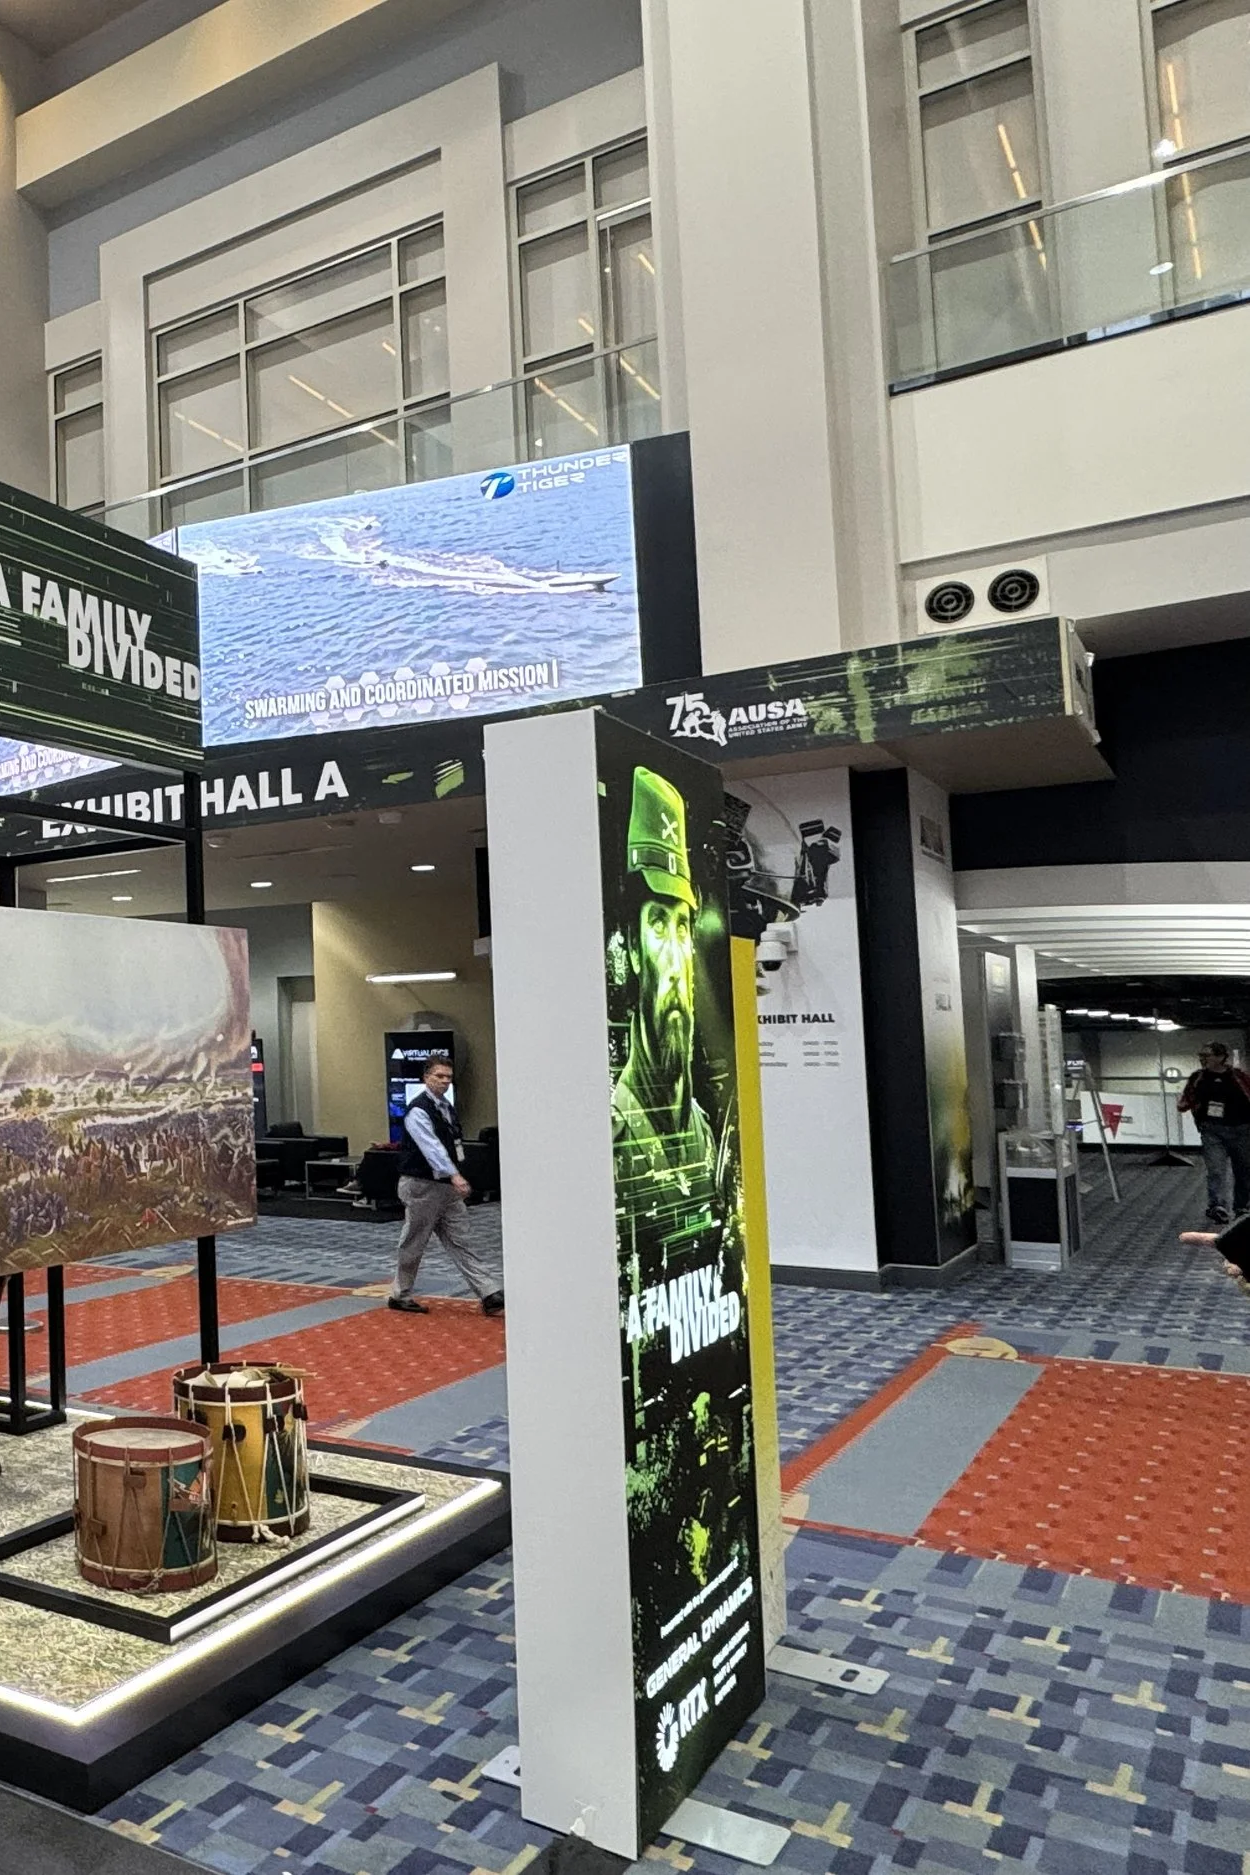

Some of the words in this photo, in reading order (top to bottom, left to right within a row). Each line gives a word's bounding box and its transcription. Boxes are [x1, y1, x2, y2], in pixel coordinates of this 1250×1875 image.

[518, 451, 628, 480] THUNDER
[518, 473, 585, 493] TIGER
[22, 571, 152, 645] FAMILY
[68, 628, 201, 701] DIVIDED
[244, 690, 326, 720] SWARMING
[328, 684, 361, 710] AND
[364, 672, 475, 705] COORDINATED
[478, 661, 549, 692] MISSION
[666, 692, 710, 731] 75
[728, 698, 807, 726] AUSA
[728, 720, 778, 733] ASSOCIATION
[780, 718, 791, 726] OF
[728, 730, 755, 739] UNITED
[757, 726, 784, 736] STATES
[786, 721, 808, 731] ARMY
[200, 767, 303, 818] HALL
[314, 760, 349, 801] A
[801, 1013, 835, 1024] HALL
[627, 1293, 643, 1344] A
[643, 1264, 714, 1339] FAMILY
[669, 1291, 741, 1365] DIVIDED
[646, 1631, 702, 1699] GENERAL
[701, 1575, 753, 1643] DYNAMICS
[679, 1676, 710, 1740] RTX
